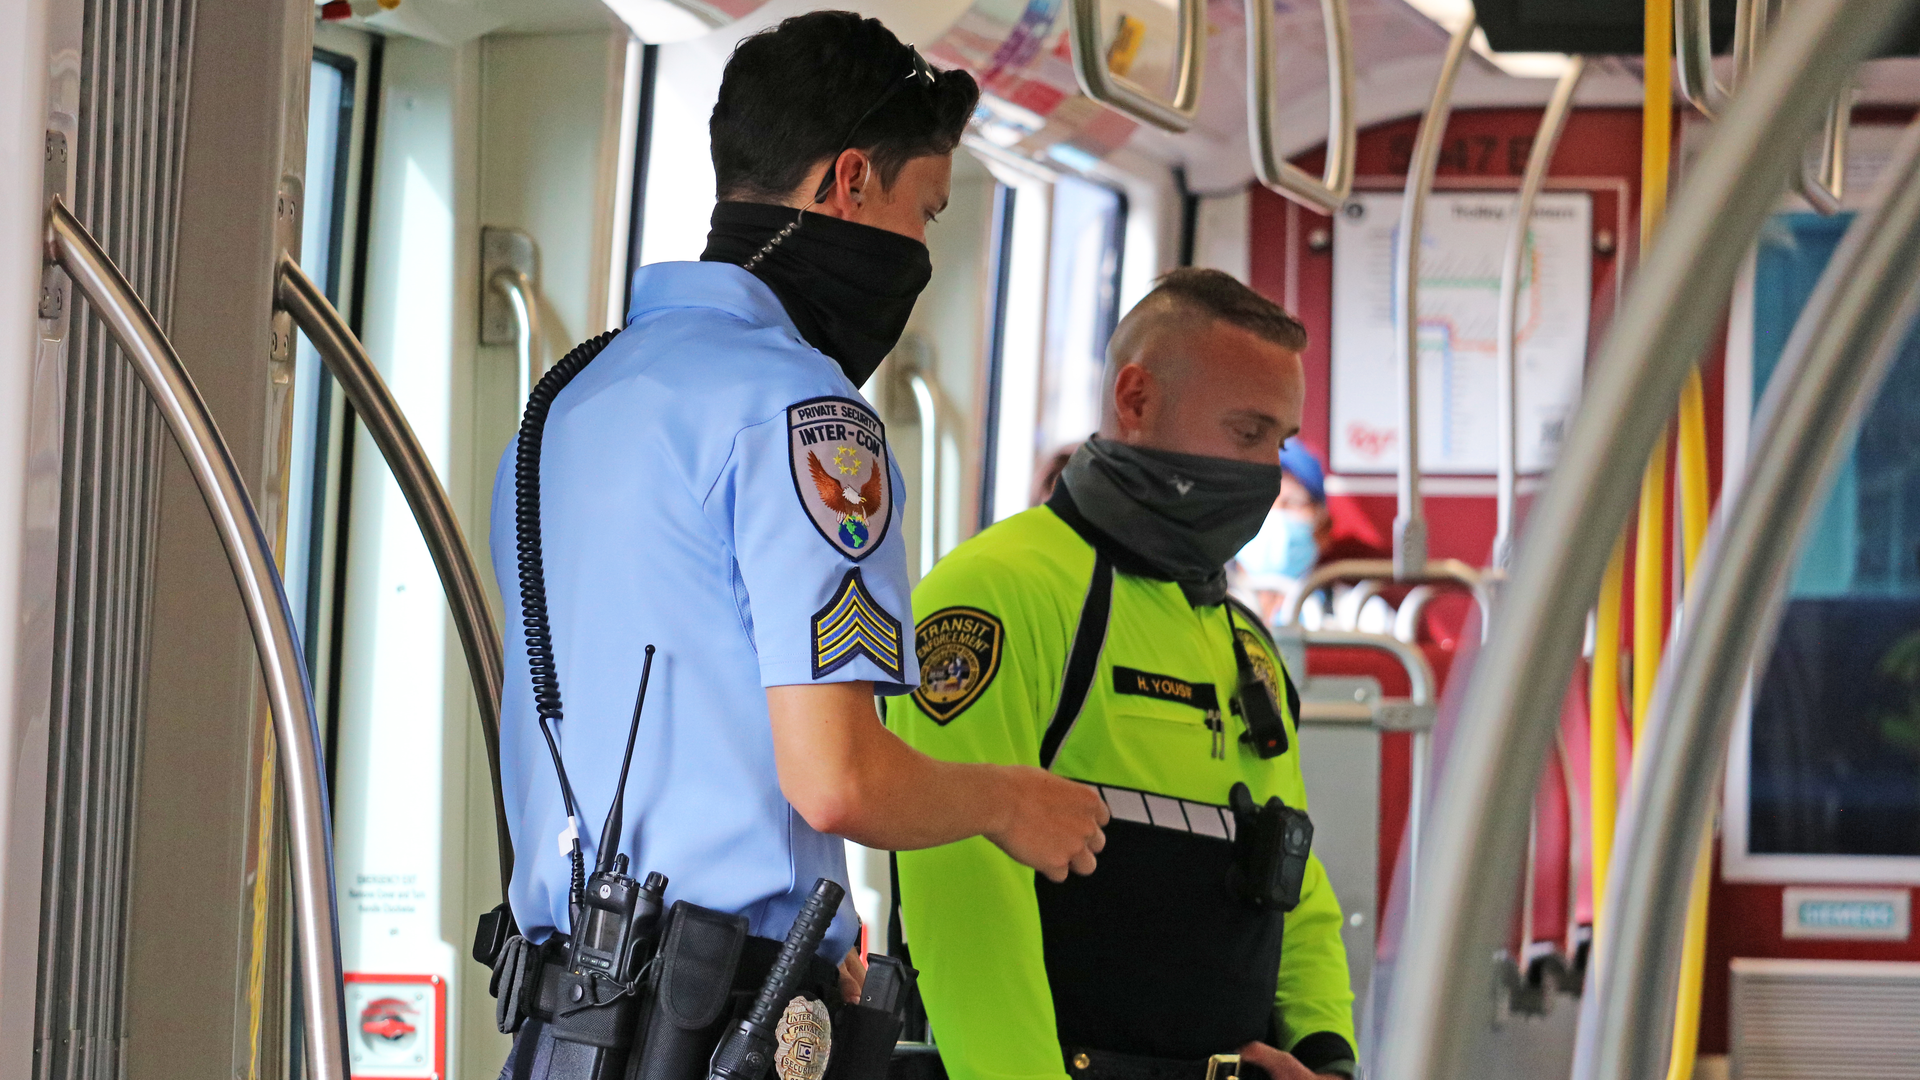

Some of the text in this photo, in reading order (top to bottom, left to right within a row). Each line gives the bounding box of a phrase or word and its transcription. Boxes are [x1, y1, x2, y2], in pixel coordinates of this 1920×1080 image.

[798, 404, 878, 432] PRIVATE SECURITY
[798, 424, 881, 458] INTER-CON
[920, 617, 991, 641] TRANSIT
[916, 631, 990, 659] ENFORCEMENT
